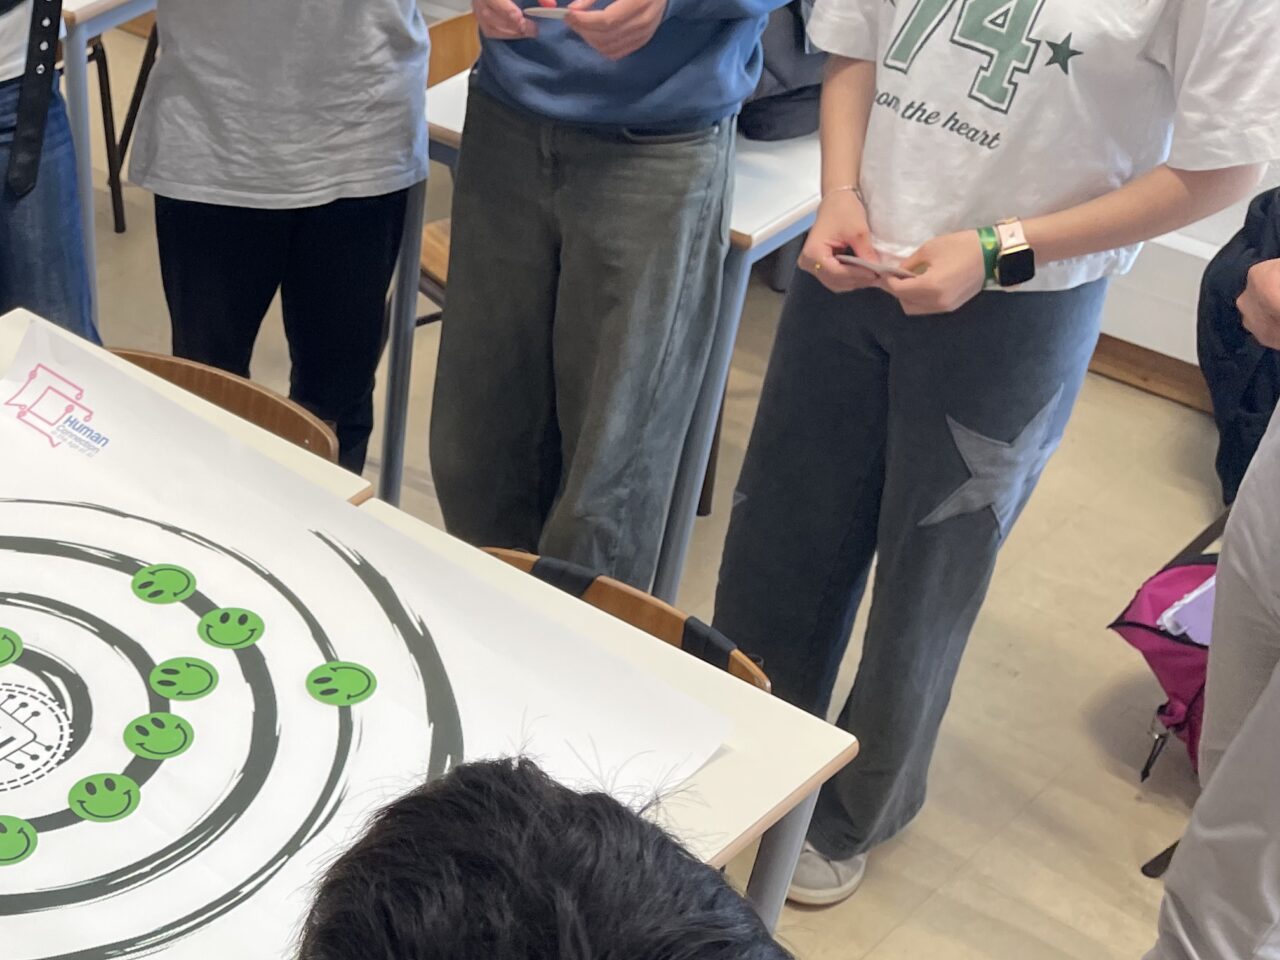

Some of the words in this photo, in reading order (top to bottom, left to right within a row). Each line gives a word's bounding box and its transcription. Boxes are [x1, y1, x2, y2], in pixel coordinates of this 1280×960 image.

[901, 101, 941, 125] the
[942, 111, 1001, 149] heart
[63, 415, 110, 447] Human
